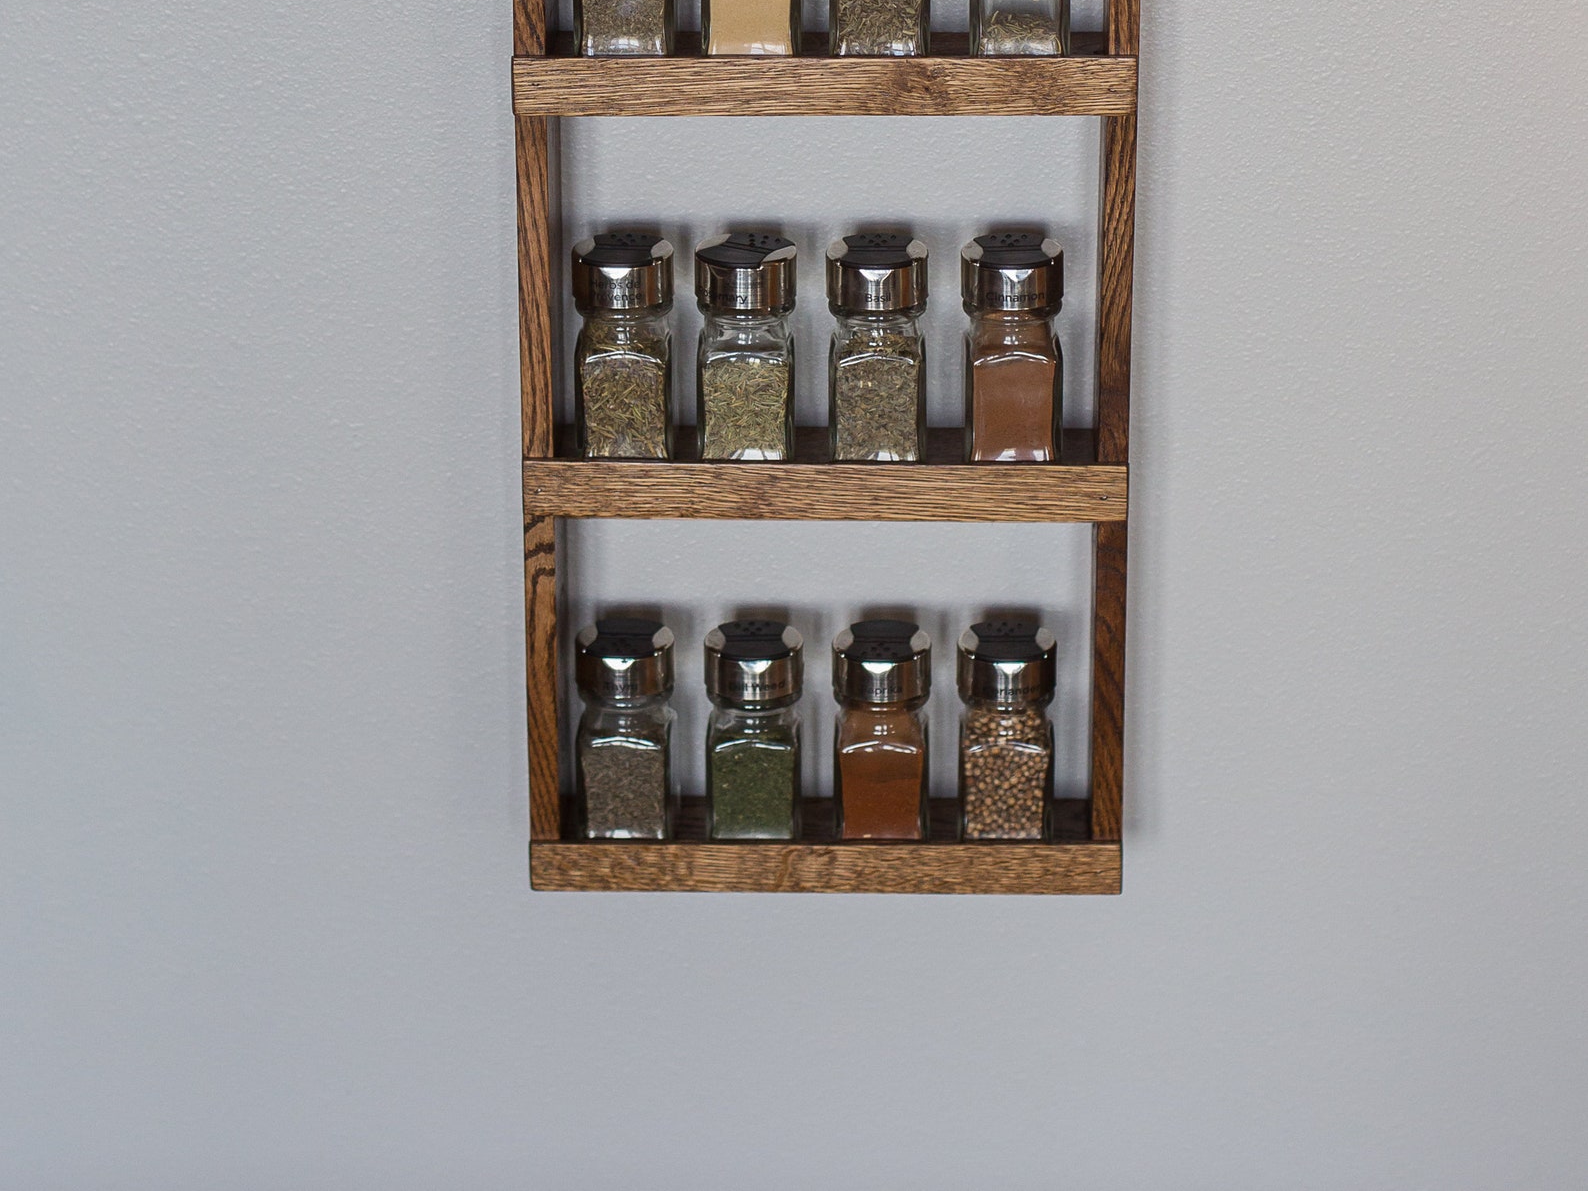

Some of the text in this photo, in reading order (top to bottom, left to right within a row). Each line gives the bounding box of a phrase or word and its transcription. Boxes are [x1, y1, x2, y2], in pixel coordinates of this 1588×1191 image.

[626, 278, 641, 290] de
[698, 286, 748, 305] Rosmary
[864, 291, 891, 303] Basil
[985, 291, 1046, 303] Cinnamon
[982, 684, 1042, 697] Criander
